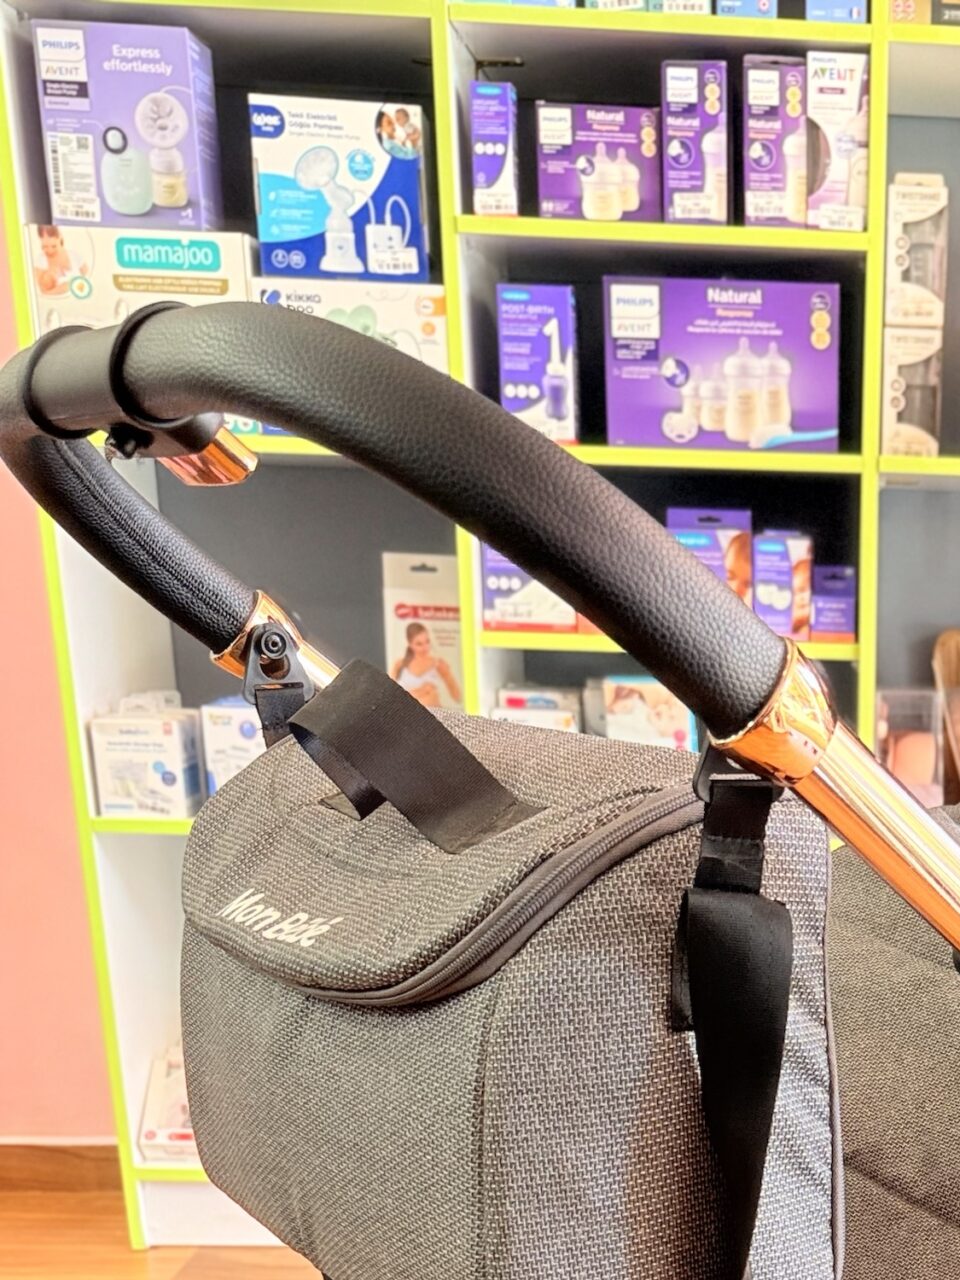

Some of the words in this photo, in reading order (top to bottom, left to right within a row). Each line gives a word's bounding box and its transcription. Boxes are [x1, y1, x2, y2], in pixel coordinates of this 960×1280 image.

[41, 40, 81, 50] PHILIPS
[112, 44, 161, 59] Express
[45, 65, 80, 76] AVENT
[102, 58, 173, 77] effortlessly
[811, 67, 856, 81] AVENT
[586, 110, 625, 122] Natural
[666, 117, 700, 128] Natural
[748, 118, 783, 130] Natural
[123, 239, 214, 270] mamajoo
[616, 296, 655, 308] PHILIPS
[707, 287, 763, 305] Natural
[616, 323, 652, 334] AVENT
